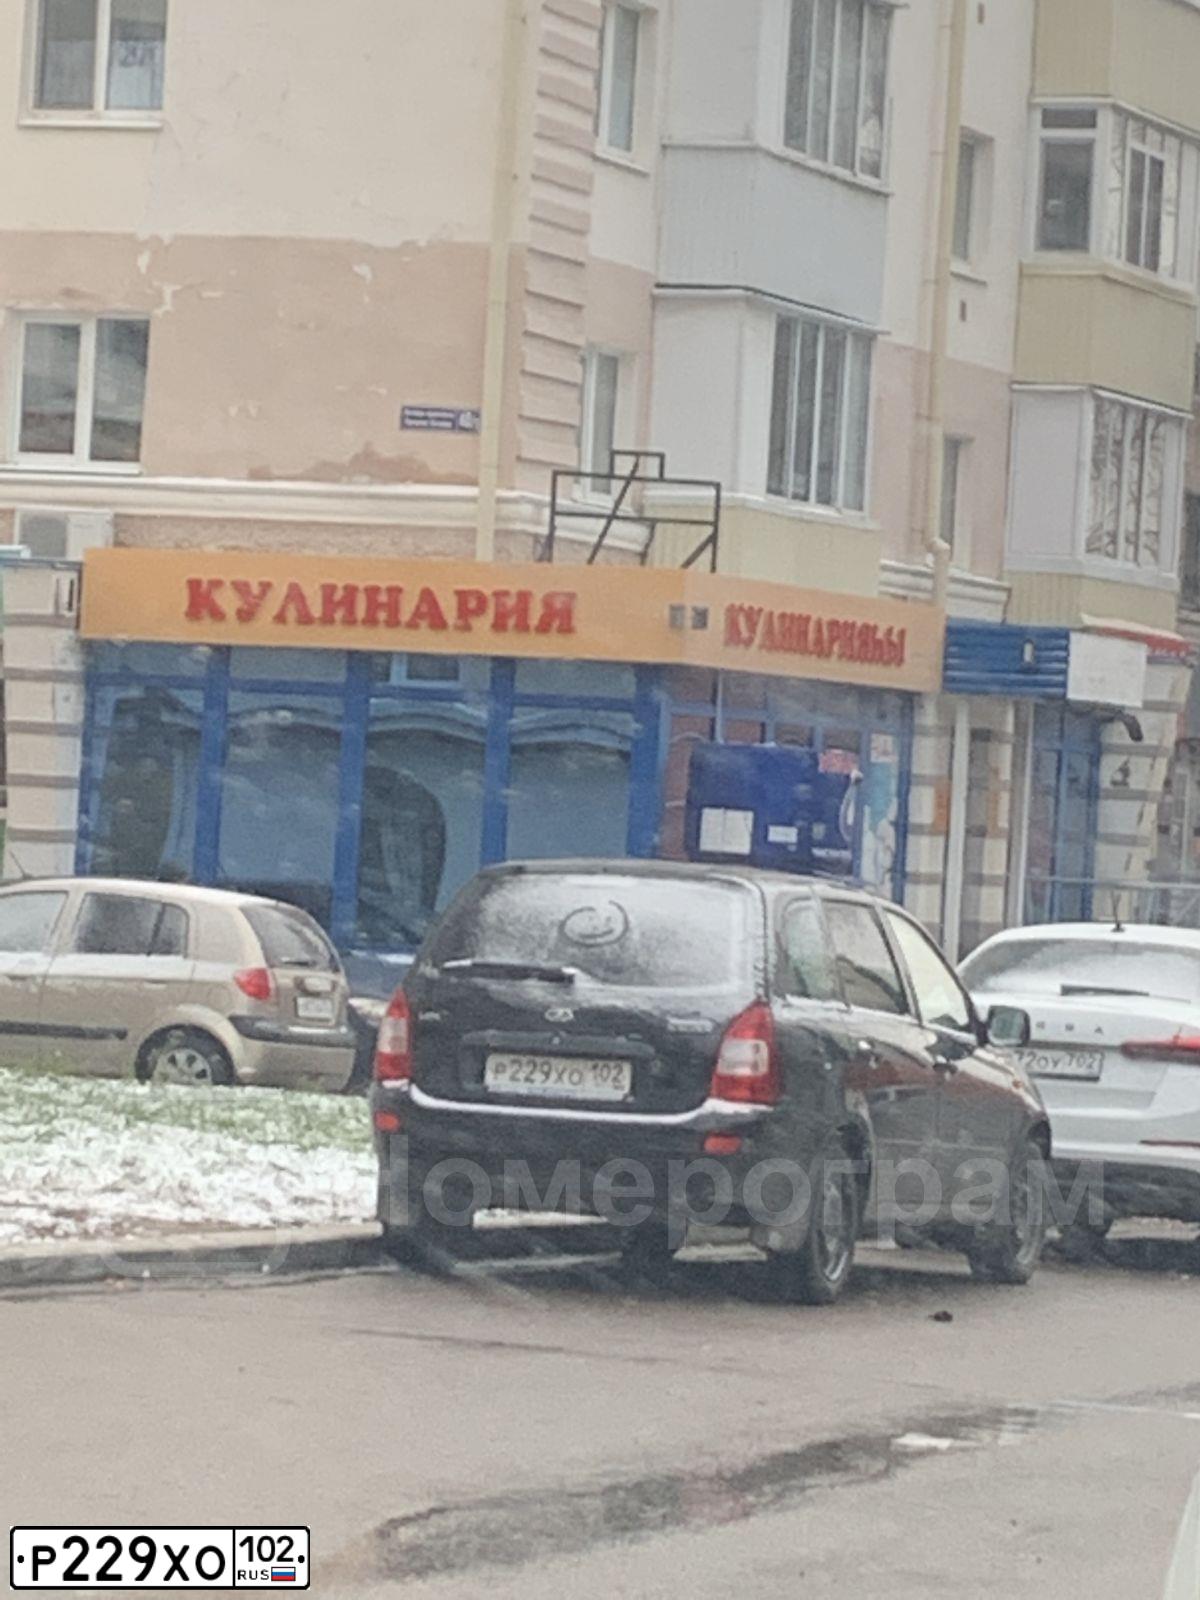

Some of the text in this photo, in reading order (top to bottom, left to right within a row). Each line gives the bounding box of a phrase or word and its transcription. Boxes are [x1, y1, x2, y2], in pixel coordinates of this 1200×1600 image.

[185, 577, 578, 635] КУЛИНАРИЯ
[494, 1058, 623, 1086] Р229ХО 102
